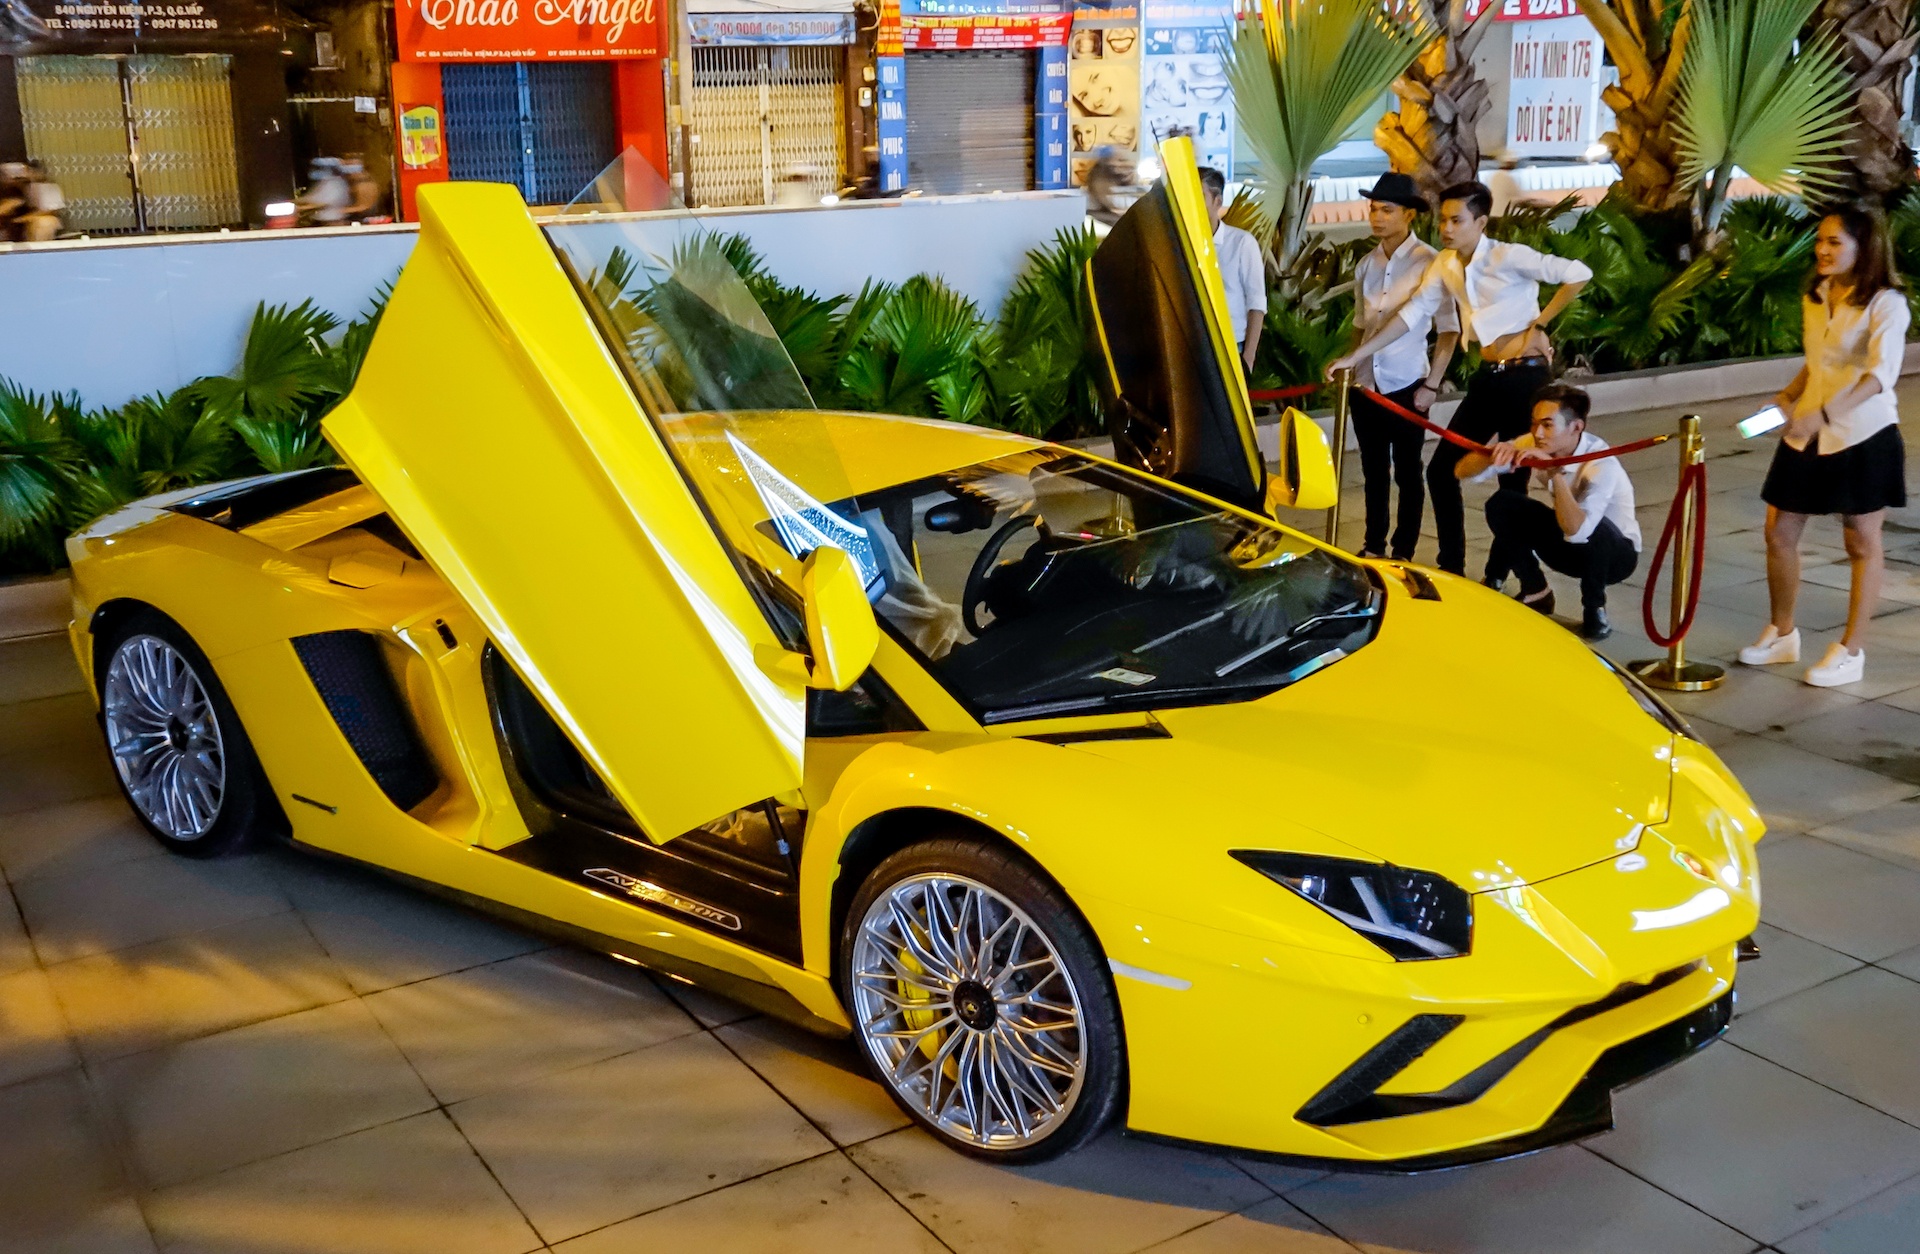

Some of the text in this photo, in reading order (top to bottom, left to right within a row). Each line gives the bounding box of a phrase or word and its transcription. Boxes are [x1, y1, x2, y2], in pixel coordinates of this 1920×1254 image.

[55, 5, 75, 15] 840
[534, 0, 656, 44] Angel
[1513, 25, 1592, 79] MẮT KÍNH 175
[882, 101, 903, 120] KHOA
[1557, 97, 1582, 142] ĐÂY
[883, 136, 903, 159] PHỤC
